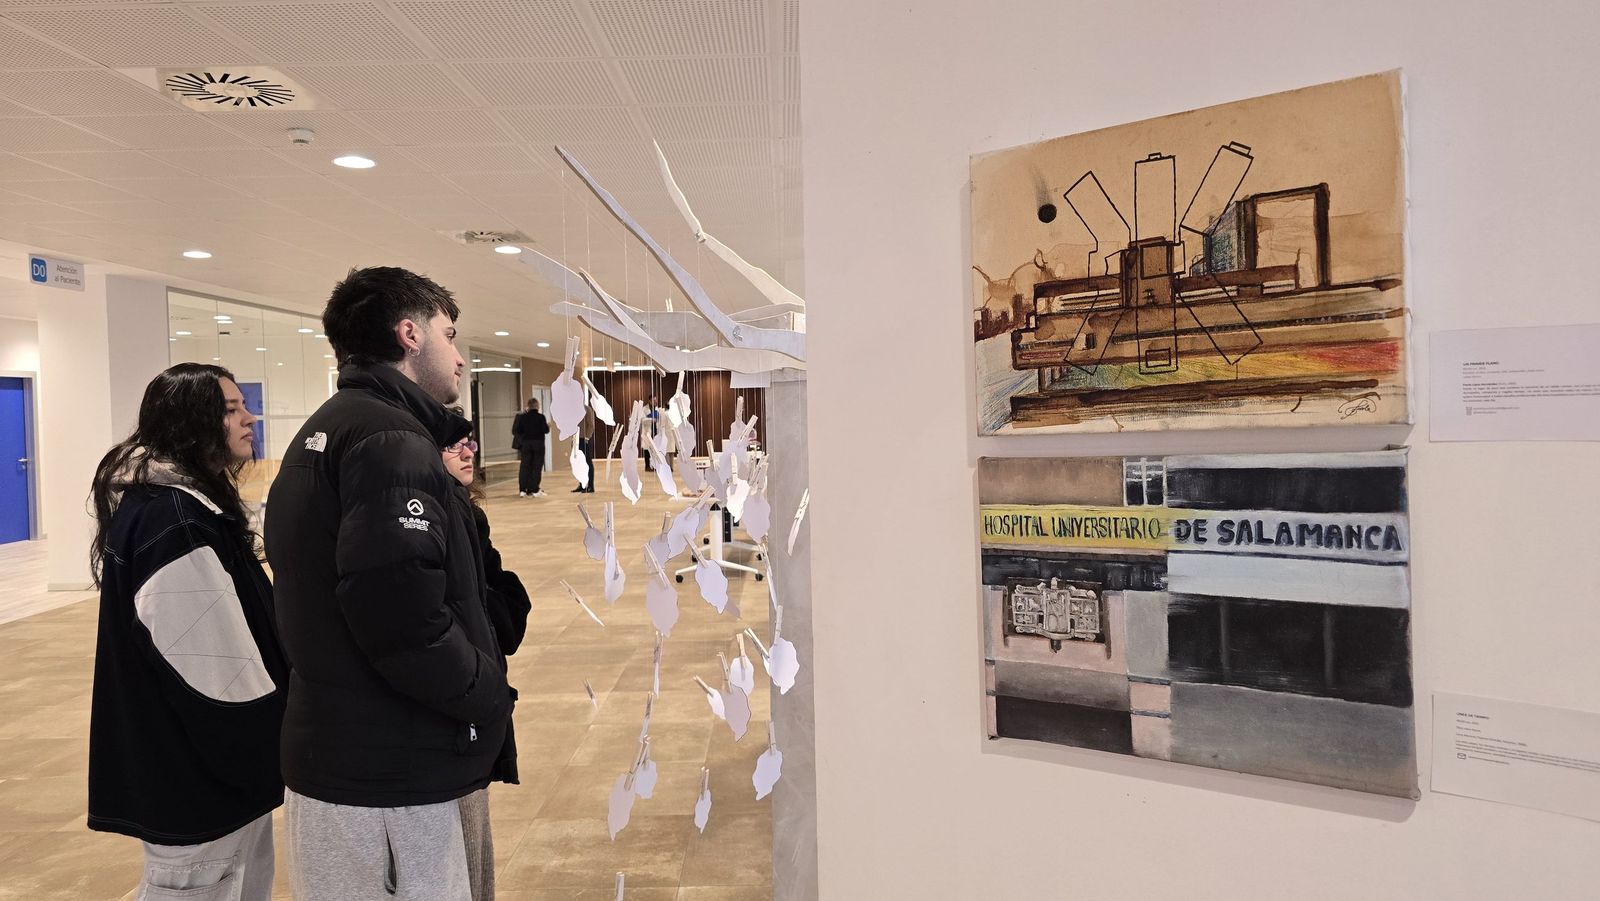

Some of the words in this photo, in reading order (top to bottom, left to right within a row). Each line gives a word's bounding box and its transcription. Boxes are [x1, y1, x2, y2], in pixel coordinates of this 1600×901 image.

[60, 276, 81, 286] Paciente
[398, 516, 430, 527] SUMMIT
[984, 514, 1049, 538] HOSPITAL
[1051, 515, 1161, 540] UNIVERSITARIO
[1175, 519, 1208, 545] DE
[1216, 517, 1403, 552] SALAMANCA
